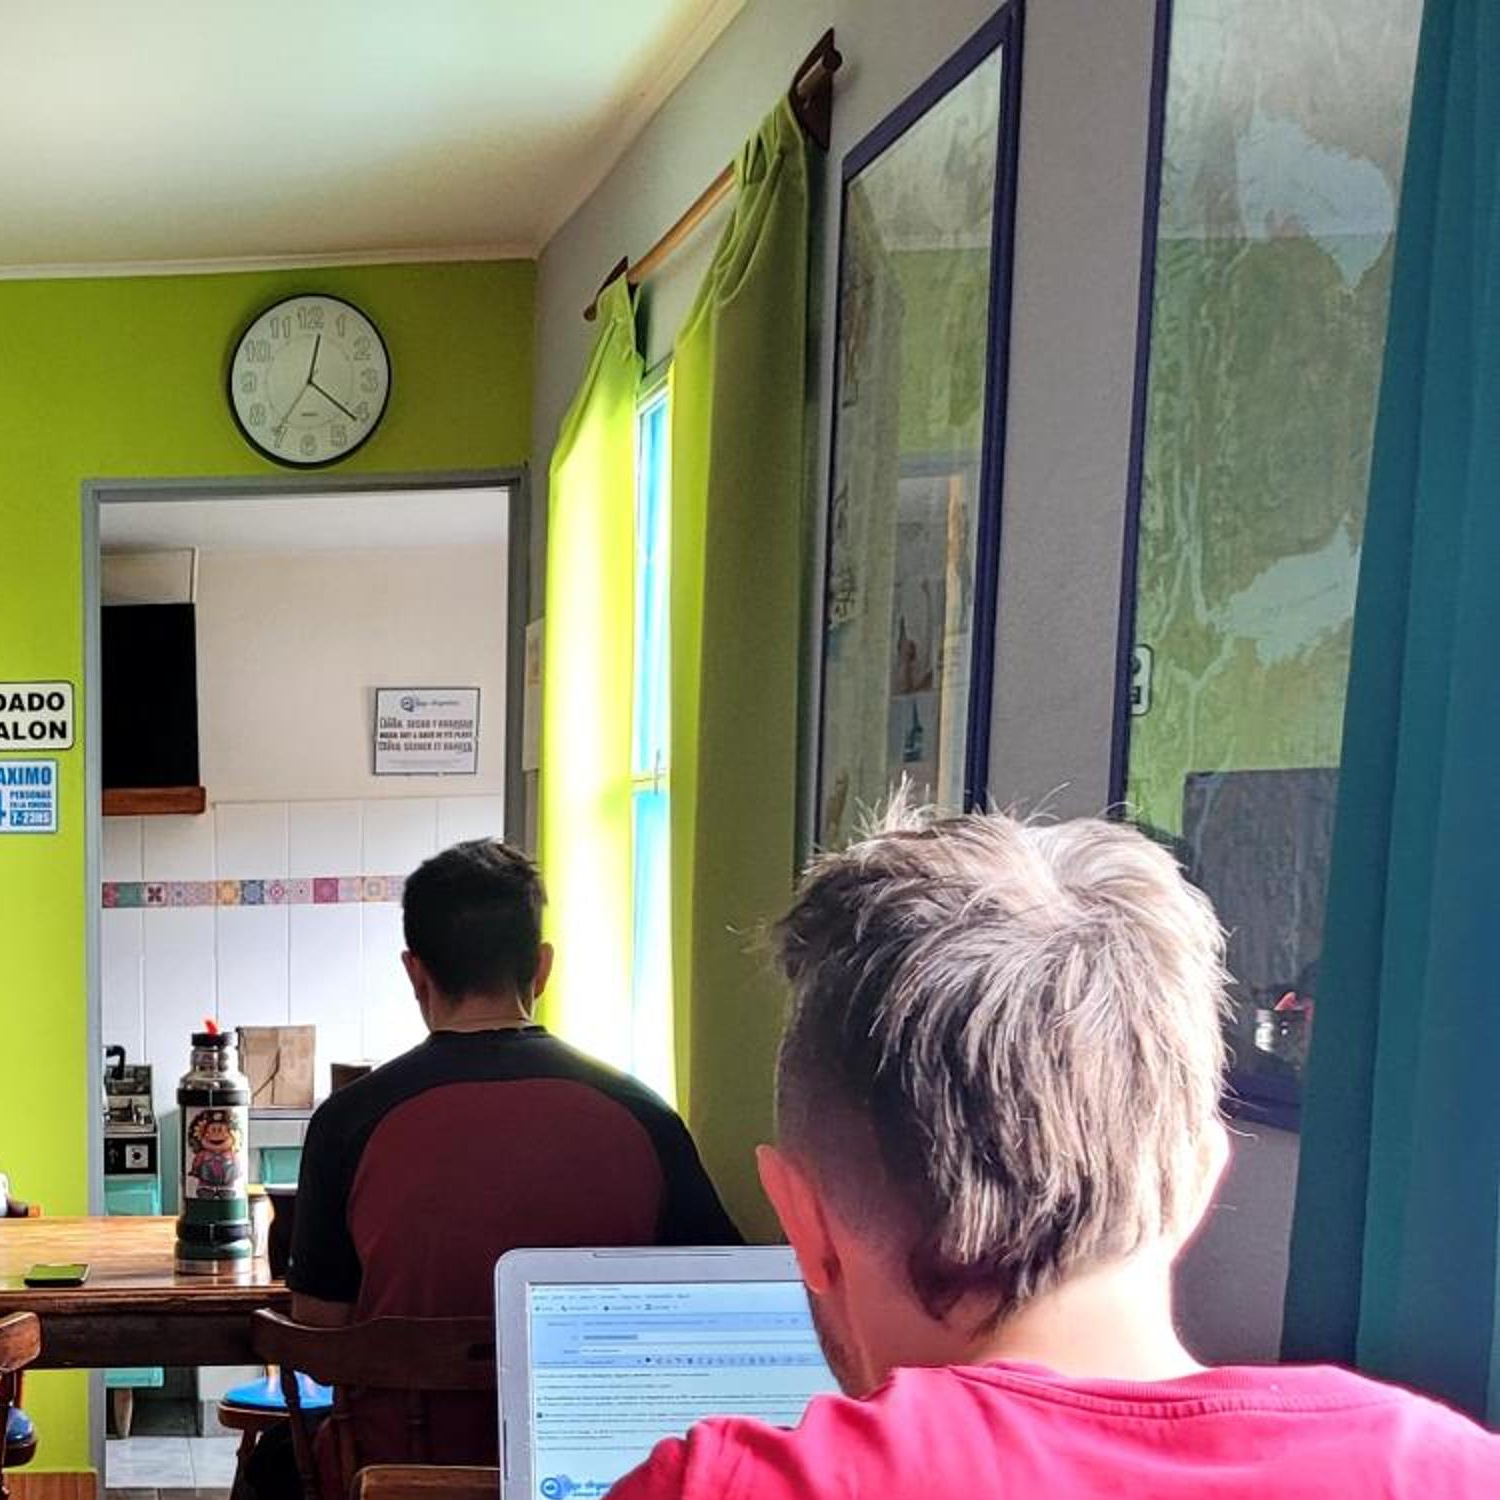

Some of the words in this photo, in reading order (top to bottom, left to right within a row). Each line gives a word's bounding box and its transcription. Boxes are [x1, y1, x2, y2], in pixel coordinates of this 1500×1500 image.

[270, 317, 292, 338] 11
[297, 306, 324, 329] 12
[354, 337, 371, 361] 2
[361, 369, 378, 393] 3
